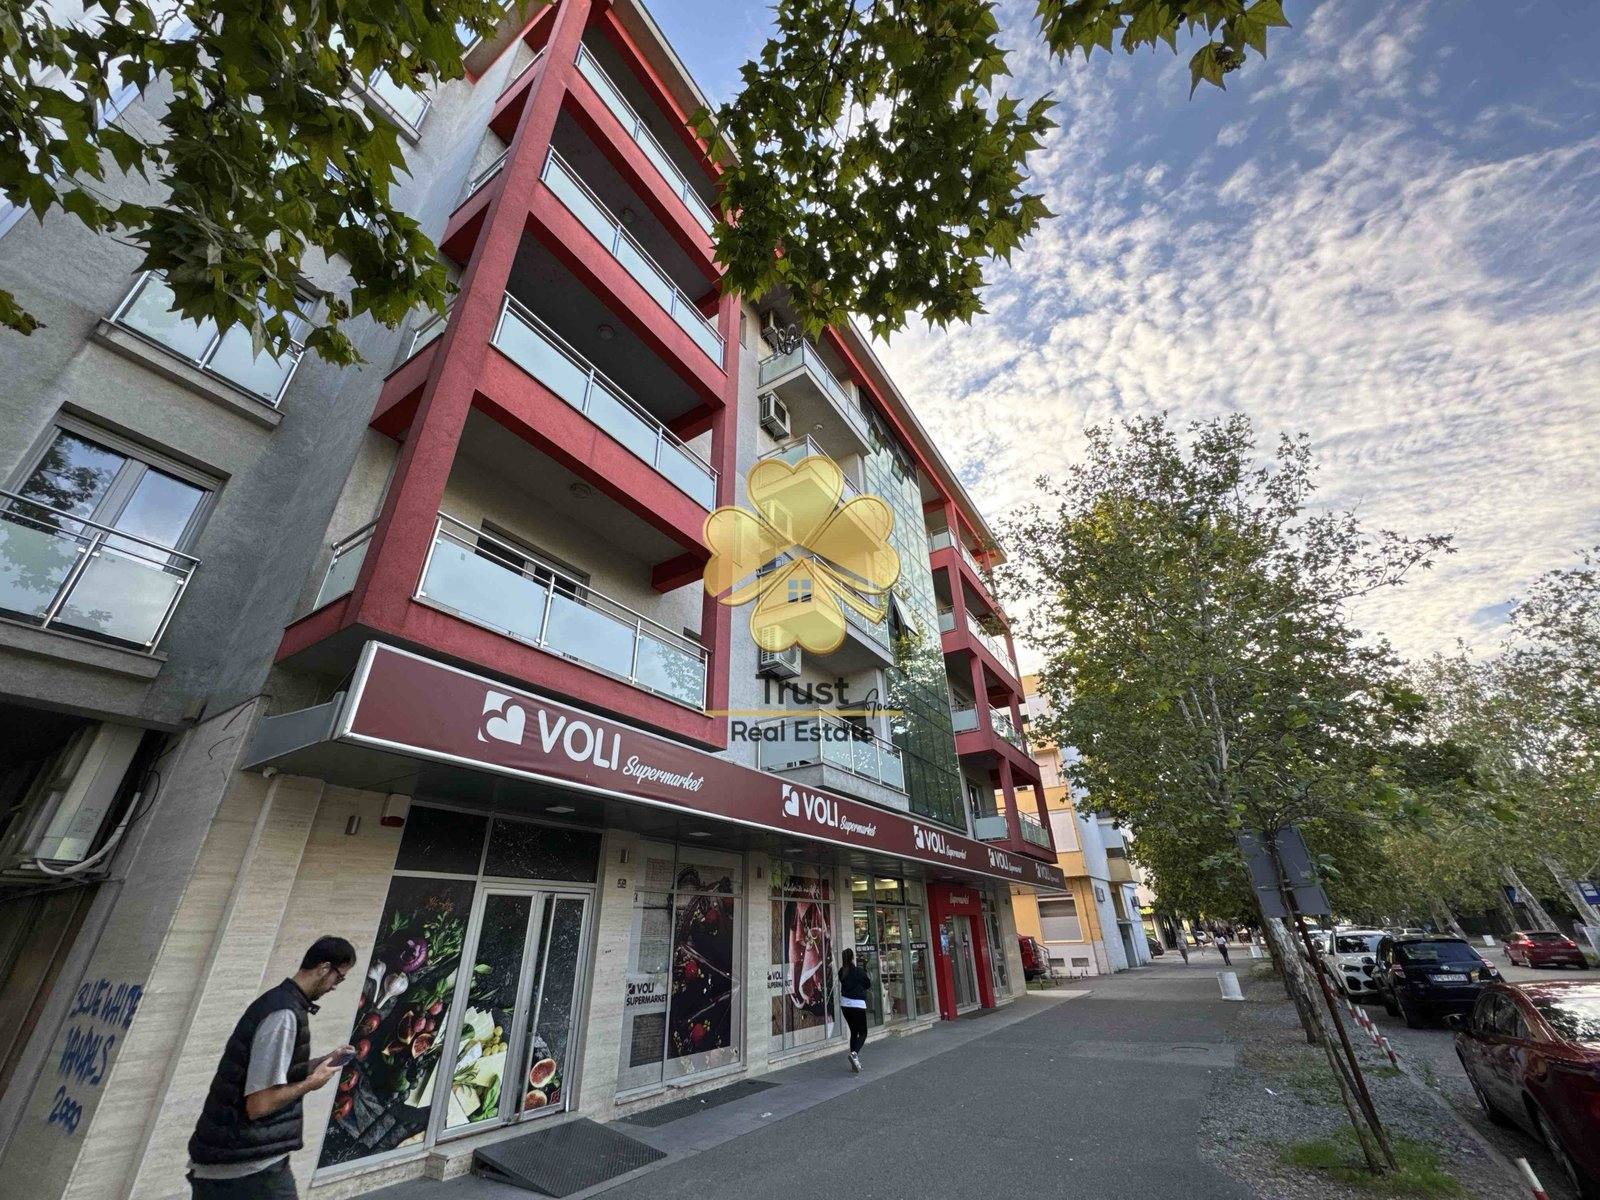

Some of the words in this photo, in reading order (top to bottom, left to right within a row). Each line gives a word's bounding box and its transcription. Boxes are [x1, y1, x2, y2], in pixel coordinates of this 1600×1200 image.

[539, 709, 621, 770] VOLI
[622, 755, 704, 792] Supermarket
[802, 792, 838, 827] VOLI
[840, 815, 877, 837] Supermarket
[924, 829, 946, 854] VOLI
[637, 982, 654, 994] VOLI
